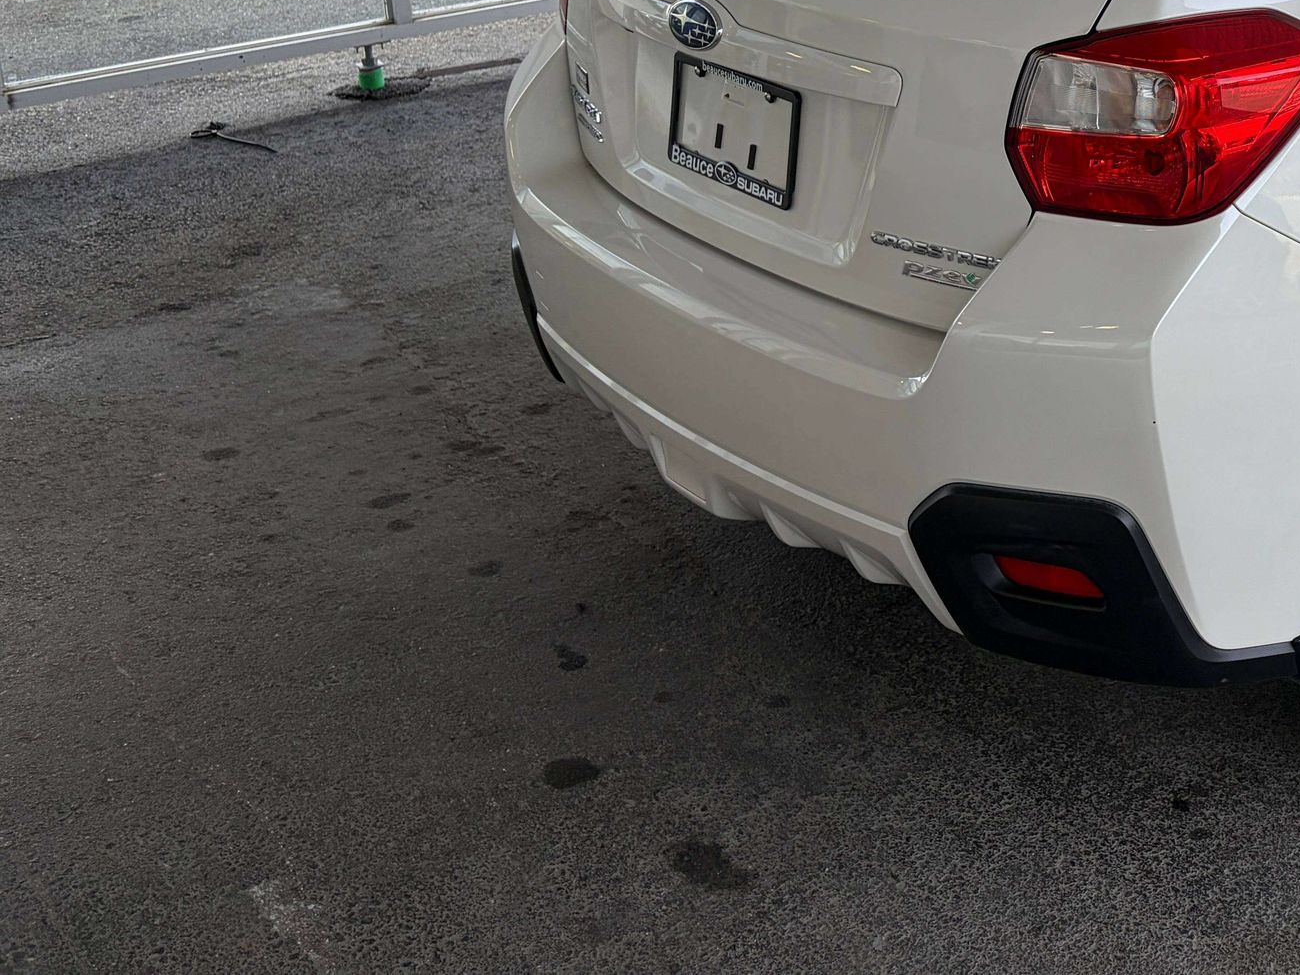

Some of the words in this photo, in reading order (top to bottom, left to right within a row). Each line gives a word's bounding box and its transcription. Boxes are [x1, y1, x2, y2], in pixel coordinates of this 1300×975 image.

[701, 60, 763, 92] beaucesubaru.com
[671, 144, 714, 177] Beauce
[737, 176, 783, 206] SUBARU
